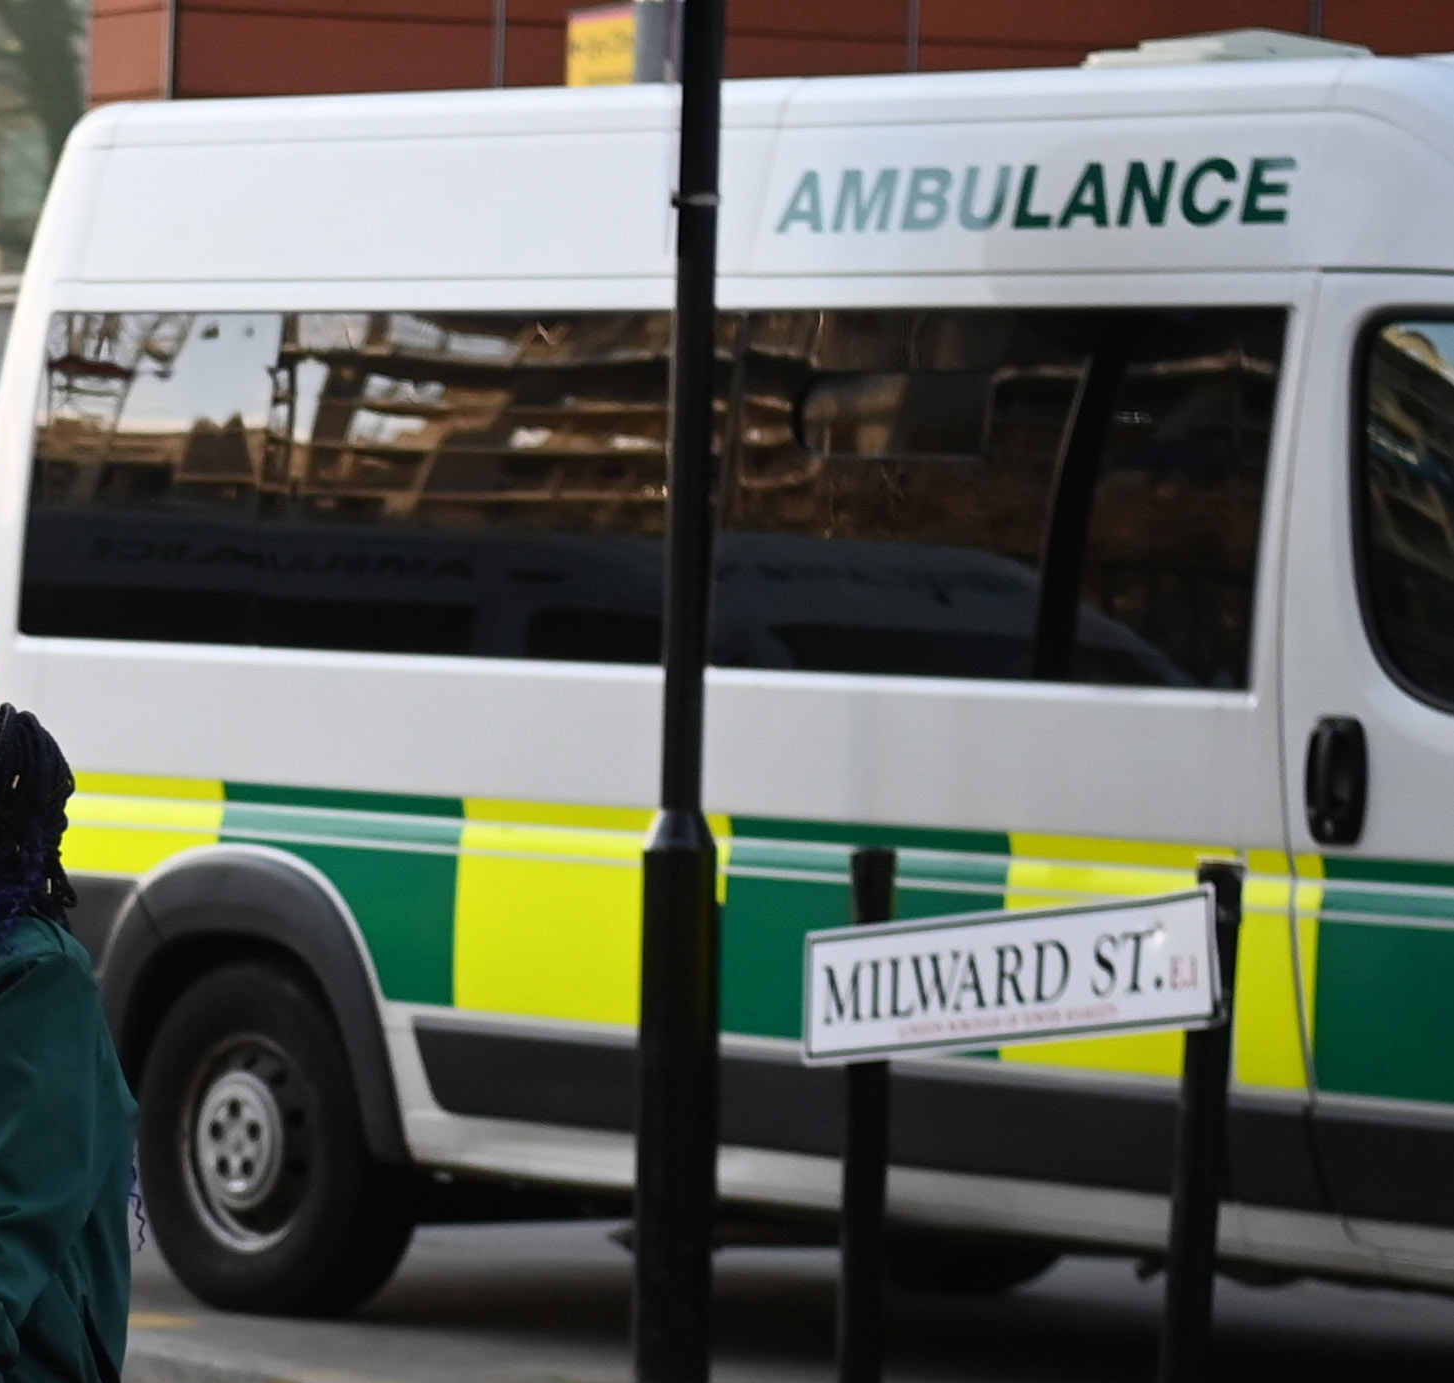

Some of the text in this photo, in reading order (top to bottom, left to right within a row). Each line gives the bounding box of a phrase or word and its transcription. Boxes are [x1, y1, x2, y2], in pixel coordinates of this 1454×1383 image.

[775, 156, 1297, 234] AMBULANCE
[824, 939, 1070, 1025] MILWARD
[1091, 922, 1166, 998] ST.
